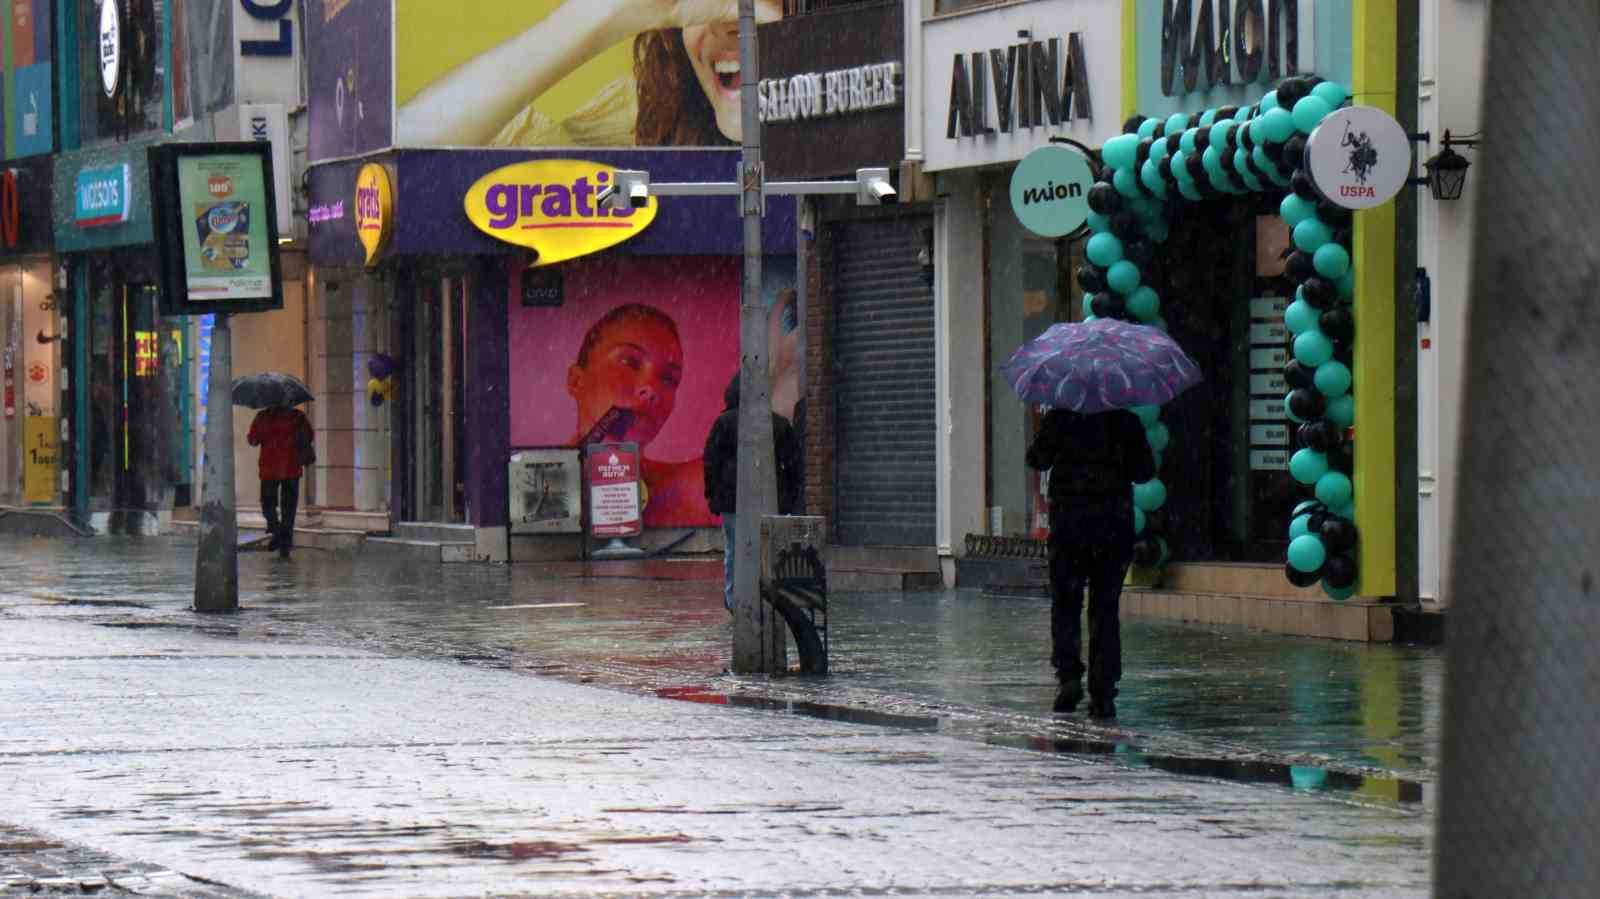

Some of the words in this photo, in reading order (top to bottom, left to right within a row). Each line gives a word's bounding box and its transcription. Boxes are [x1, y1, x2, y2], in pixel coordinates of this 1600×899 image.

[758, 72, 822, 123] SALOON
[825, 61, 897, 113] BURGER
[946, 29, 1093, 139] ALVİNA
[357, 175, 380, 231] gratis
[485, 171, 637, 229] grati
[1023, 180, 1082, 205] mion
[1340, 186, 1375, 198] USPA
